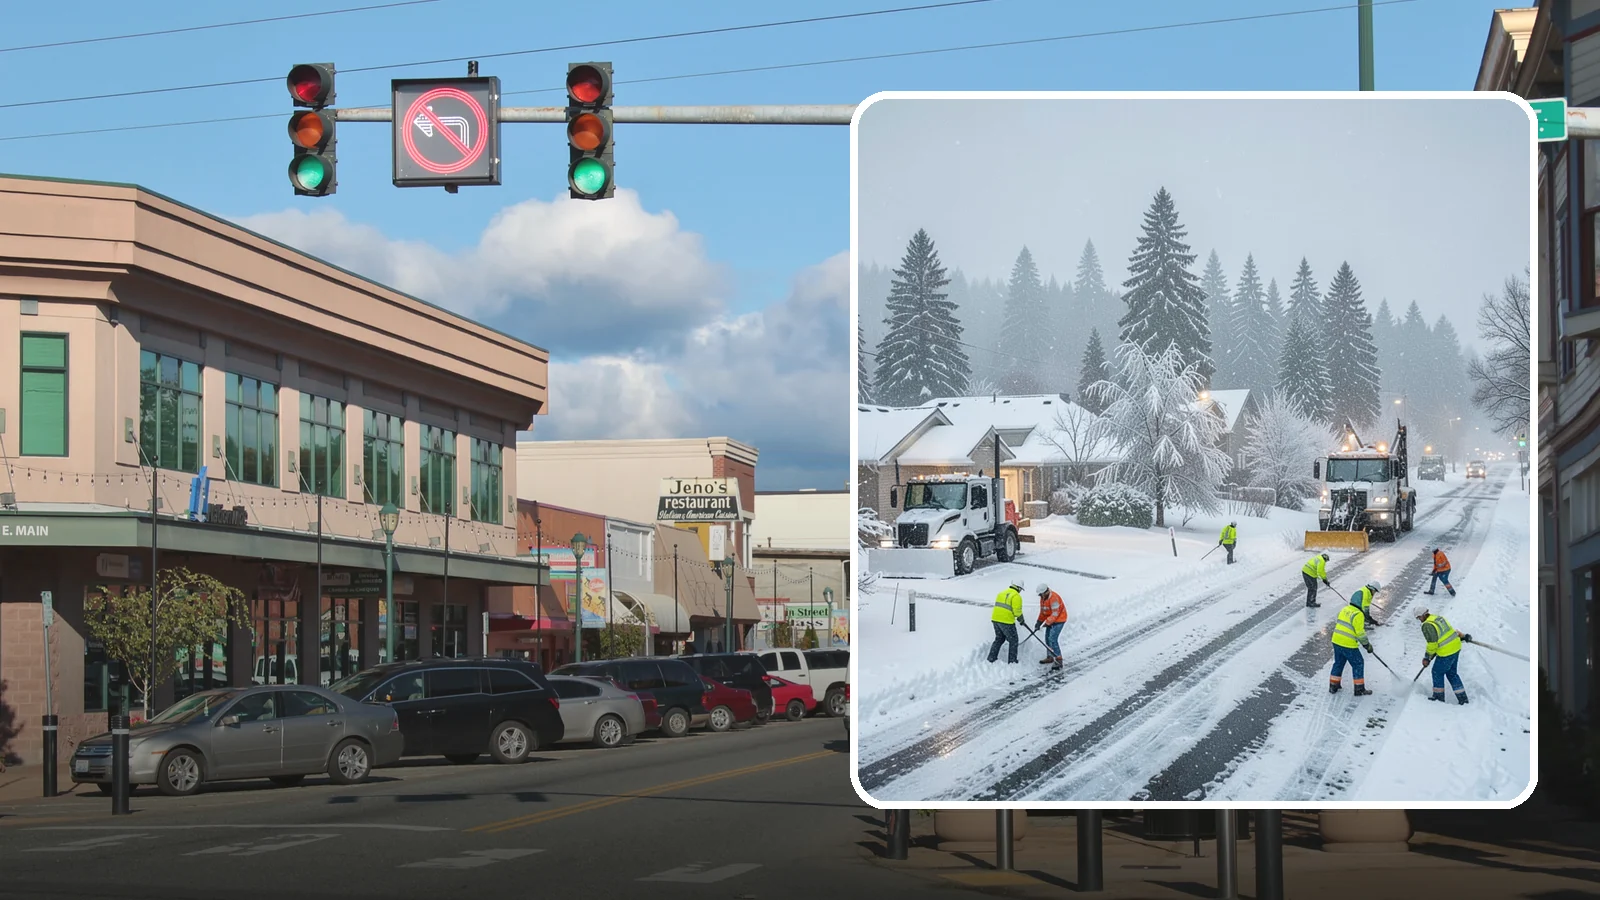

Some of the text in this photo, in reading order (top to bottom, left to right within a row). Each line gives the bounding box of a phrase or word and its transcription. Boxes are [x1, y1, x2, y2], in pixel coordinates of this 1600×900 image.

[670, 480, 727, 494] Jeno's
[665, 496, 731, 509] restaurant
[658, 510, 682, 519] Italian
[686, 509, 715, 519] American
[715, 509, 738, 519] Cuisine
[2, 525, 49, 536] E. MAIN
[798, 608, 828, 616] Street
[791, 619, 824, 627] lass
